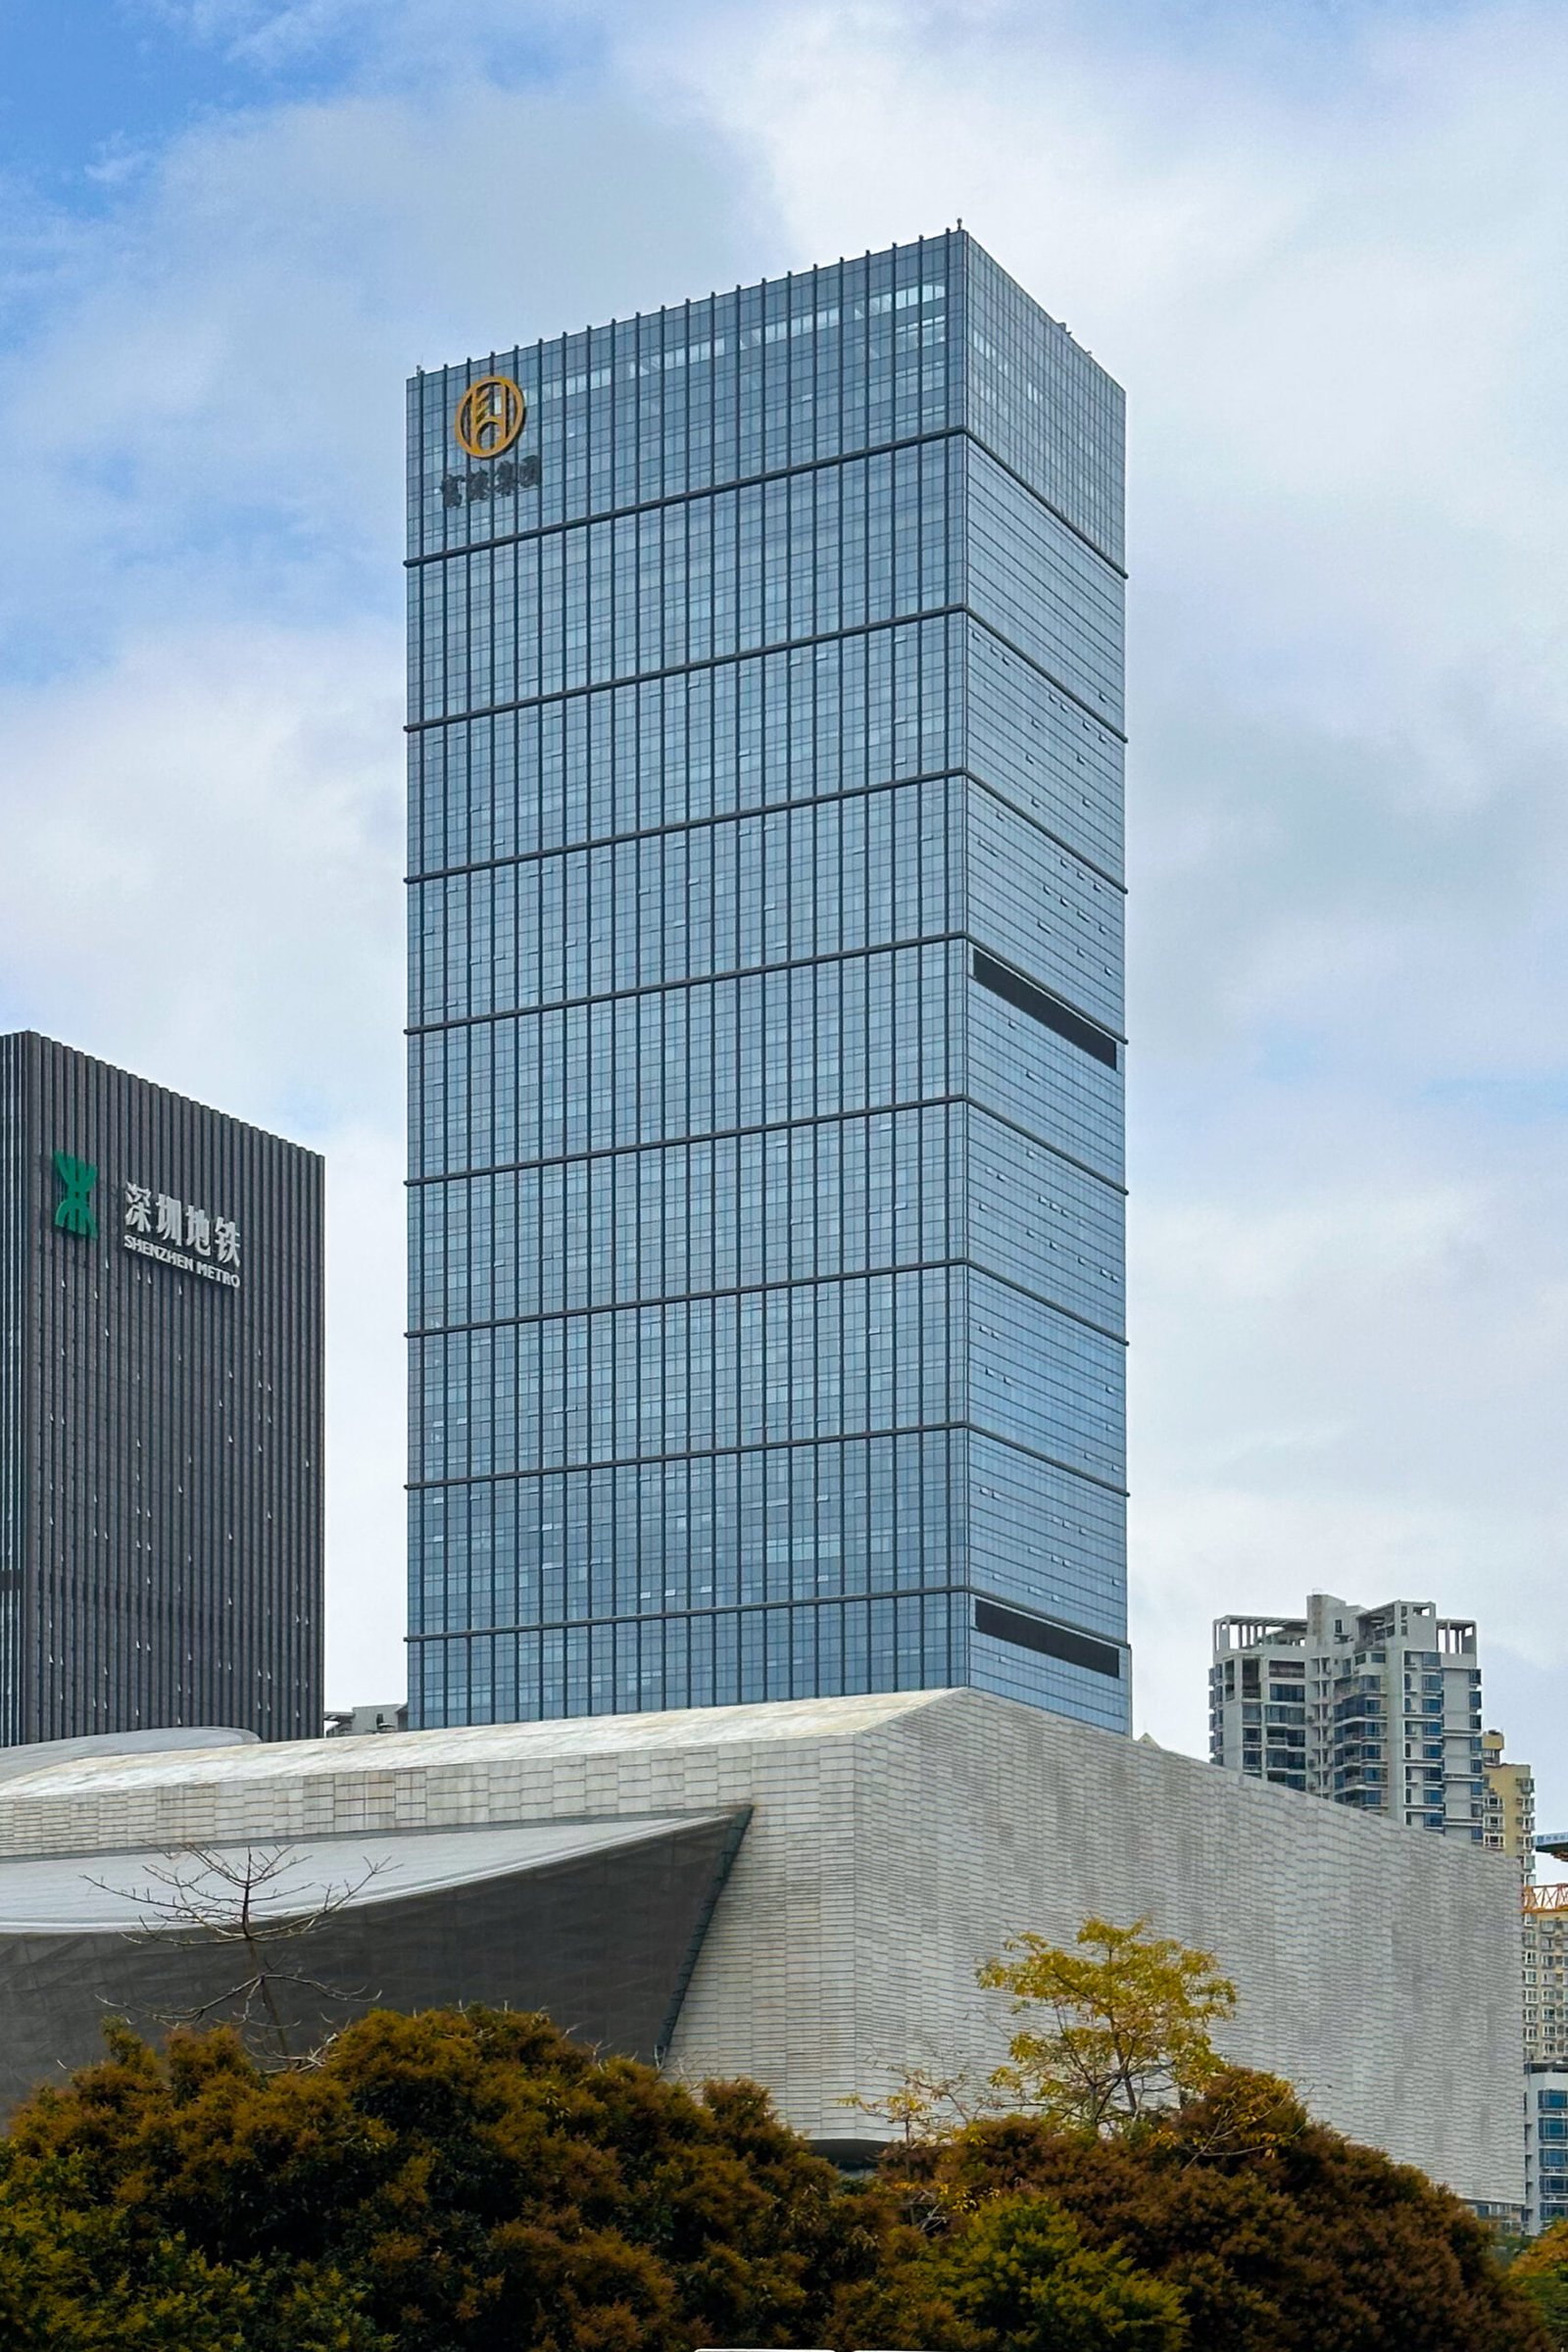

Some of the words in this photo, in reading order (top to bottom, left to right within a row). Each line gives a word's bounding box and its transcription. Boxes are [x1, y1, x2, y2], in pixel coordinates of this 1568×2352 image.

[124, 1180, 240, 1267] 深圳地铁
[124, 1235, 194, 1271] SHENZHEN
[197, 1260, 240, 1288] METRO
